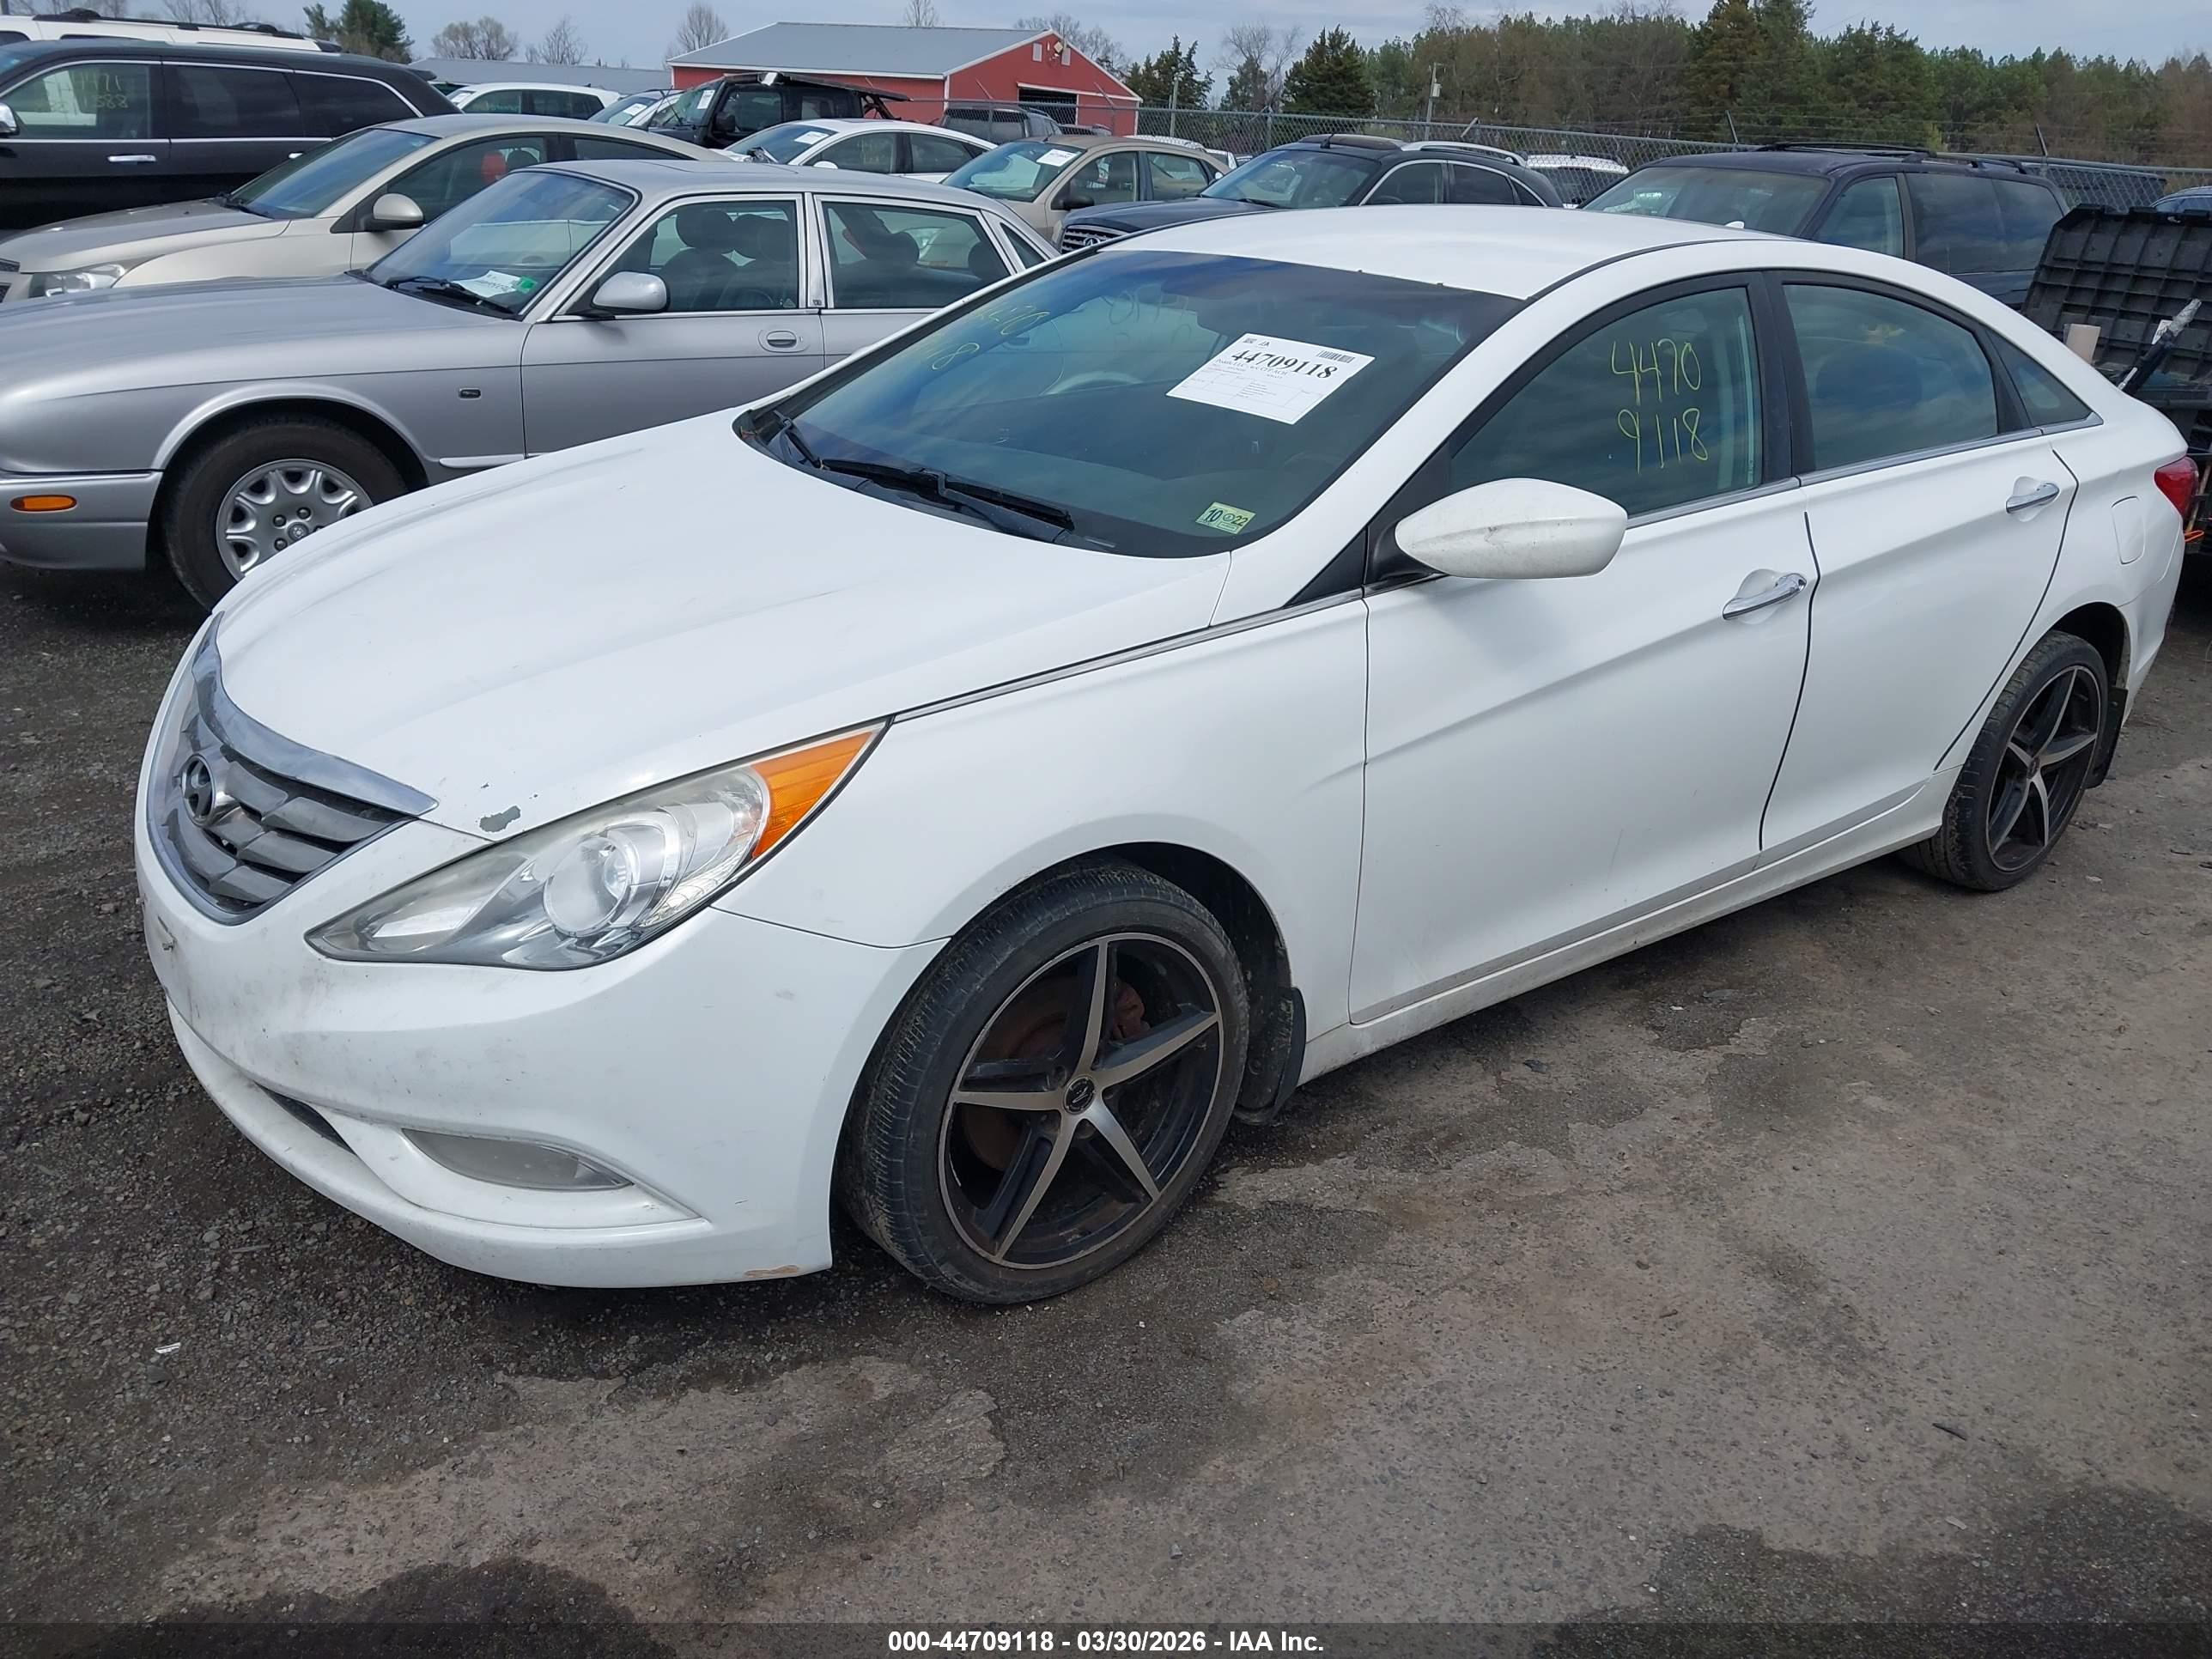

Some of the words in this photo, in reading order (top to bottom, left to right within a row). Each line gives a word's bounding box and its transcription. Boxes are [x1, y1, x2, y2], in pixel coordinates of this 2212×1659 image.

[1231, 349, 1339, 379] 44709118
[1611, 337, 1702, 406] 4470
[1617, 407, 1709, 474] 9118
